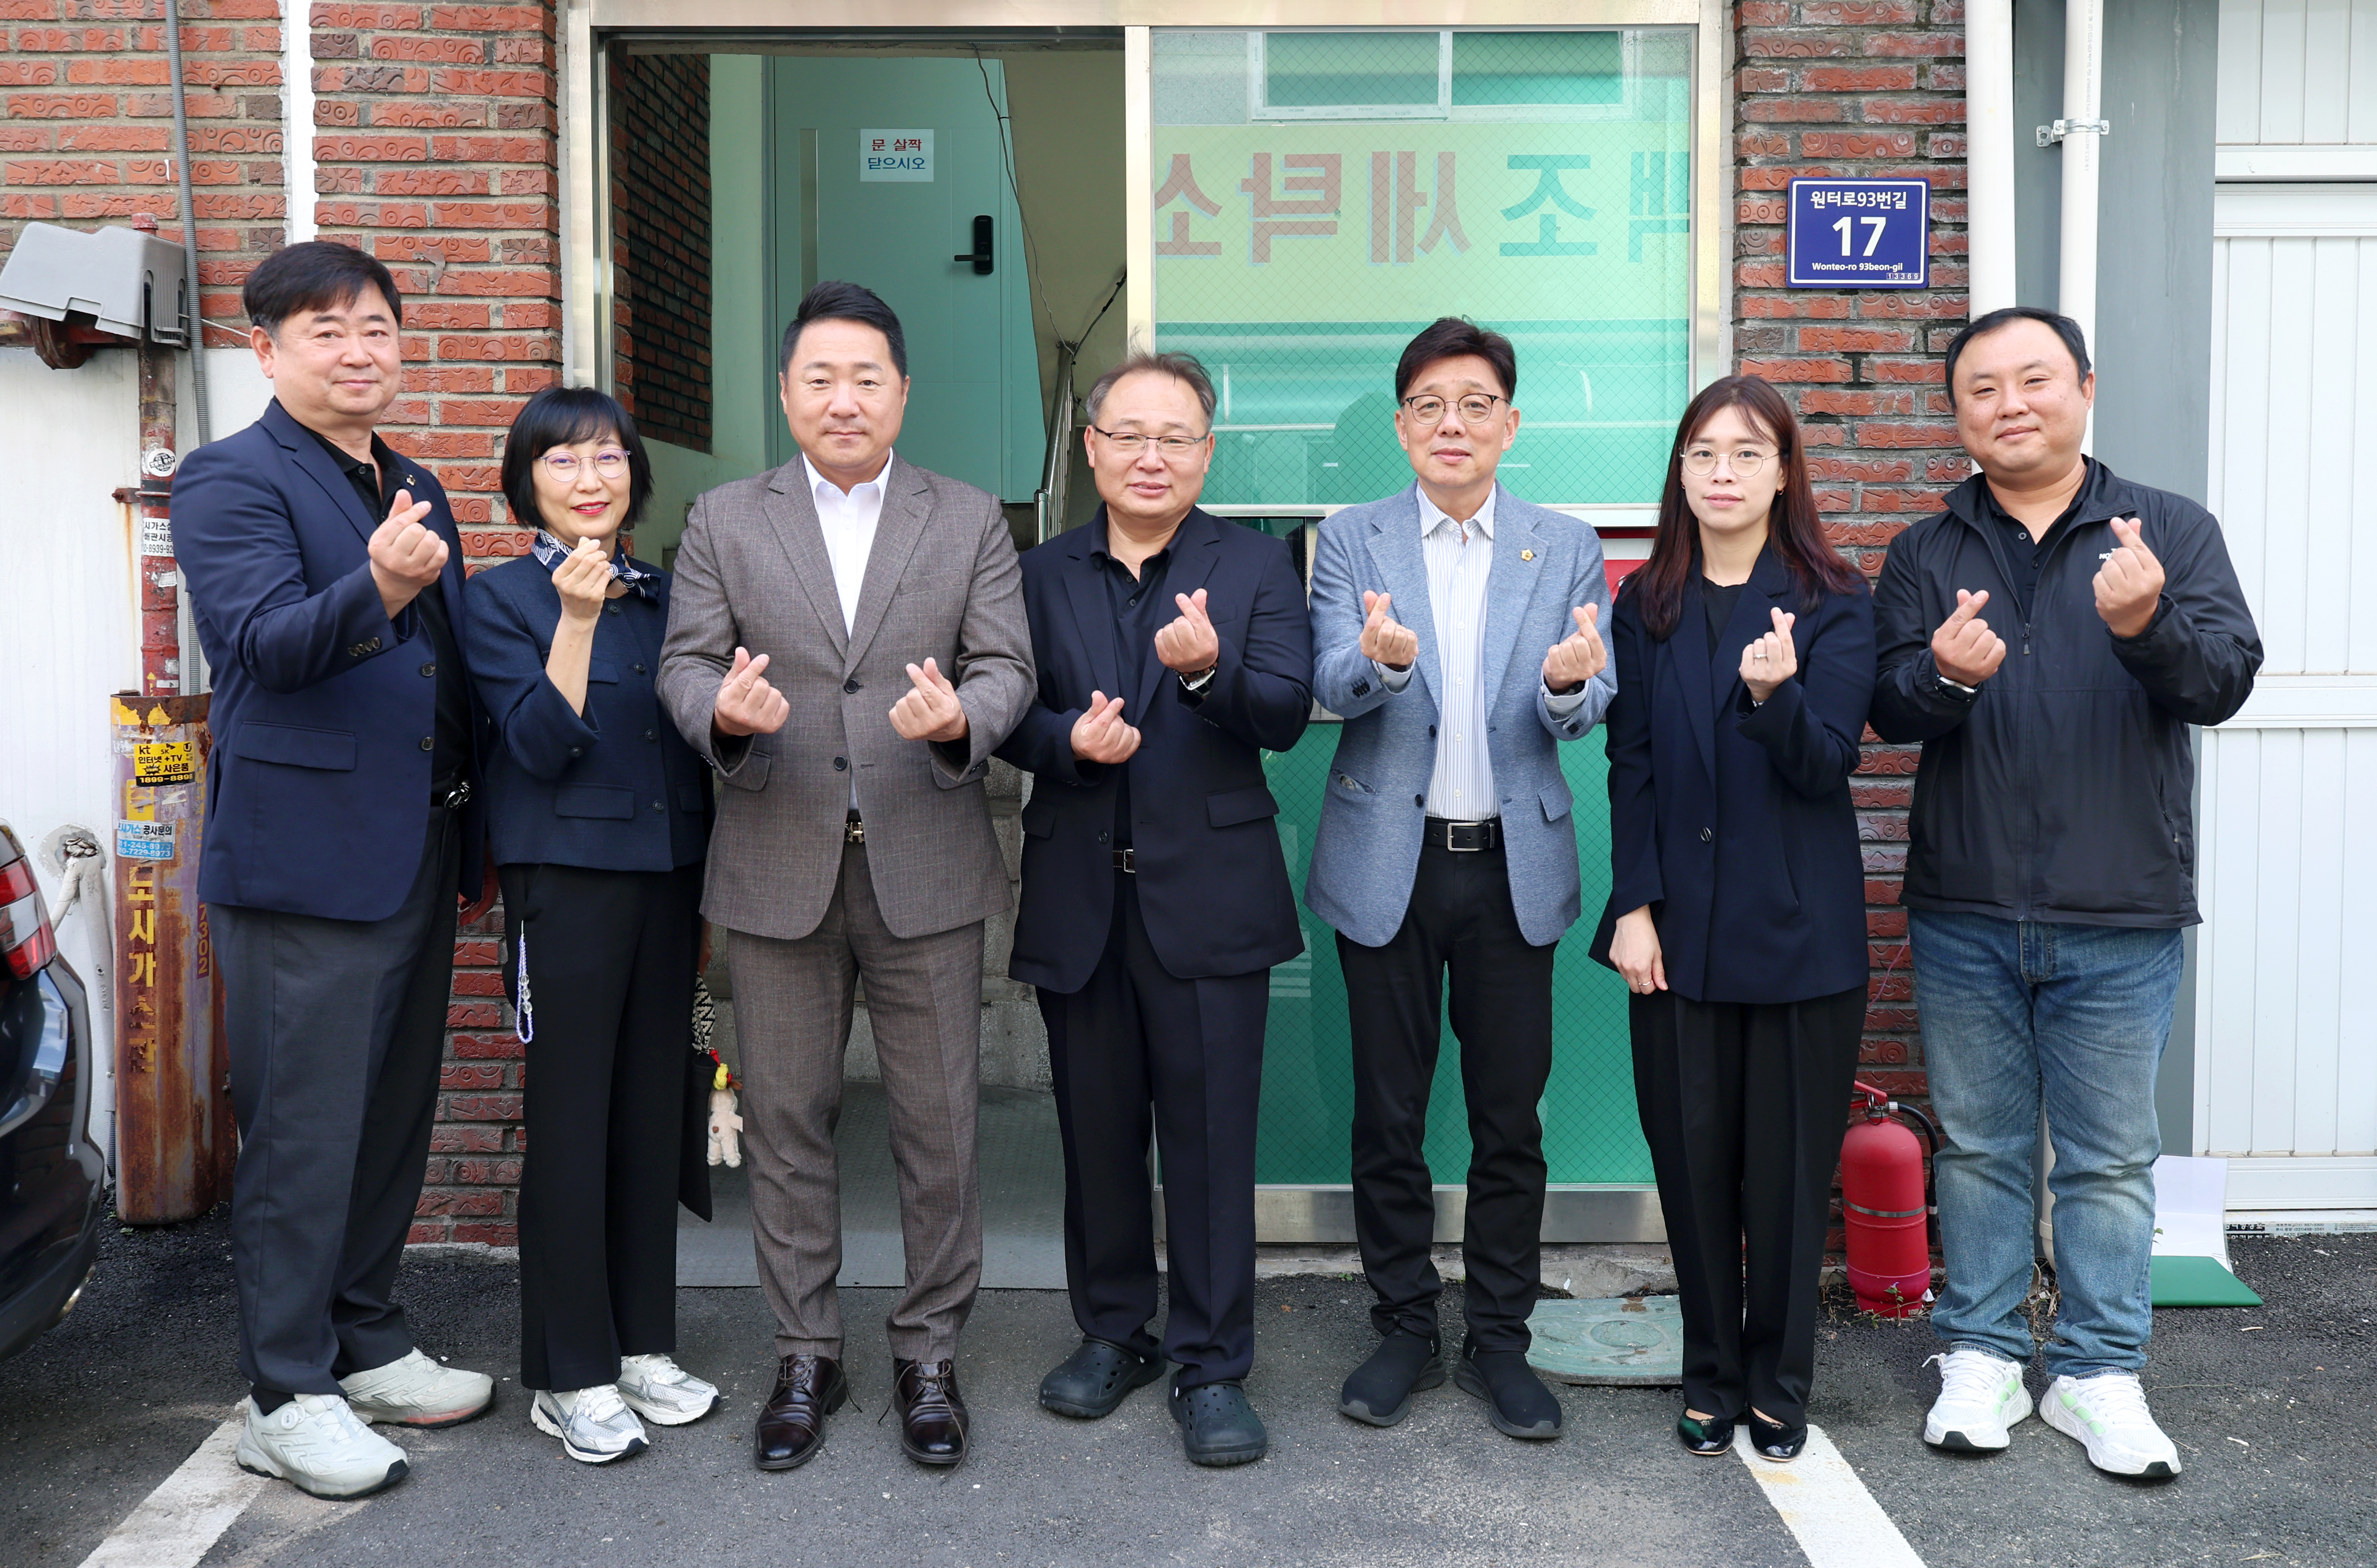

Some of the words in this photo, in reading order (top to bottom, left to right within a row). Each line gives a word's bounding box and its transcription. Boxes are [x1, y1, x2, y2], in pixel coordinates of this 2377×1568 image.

[872, 139, 885, 151] 문
[893, 138, 922, 152] 살짝
[868, 157, 926, 170] 닫으시오
[1810, 191, 1907, 209] 원터로93번길
[1832, 216, 1886, 256] 17
[1812, 262, 1857, 271] Wonteo-ro
[1859, 262, 1903, 272] 93beon-gil
[139, 745, 151, 755] kt
[138, 756, 162, 764] 인터넷
[163, 763, 189, 773] 사은품
[139, 774, 193, 783] 1899-8898
[143, 825, 172, 835] 공사문의
